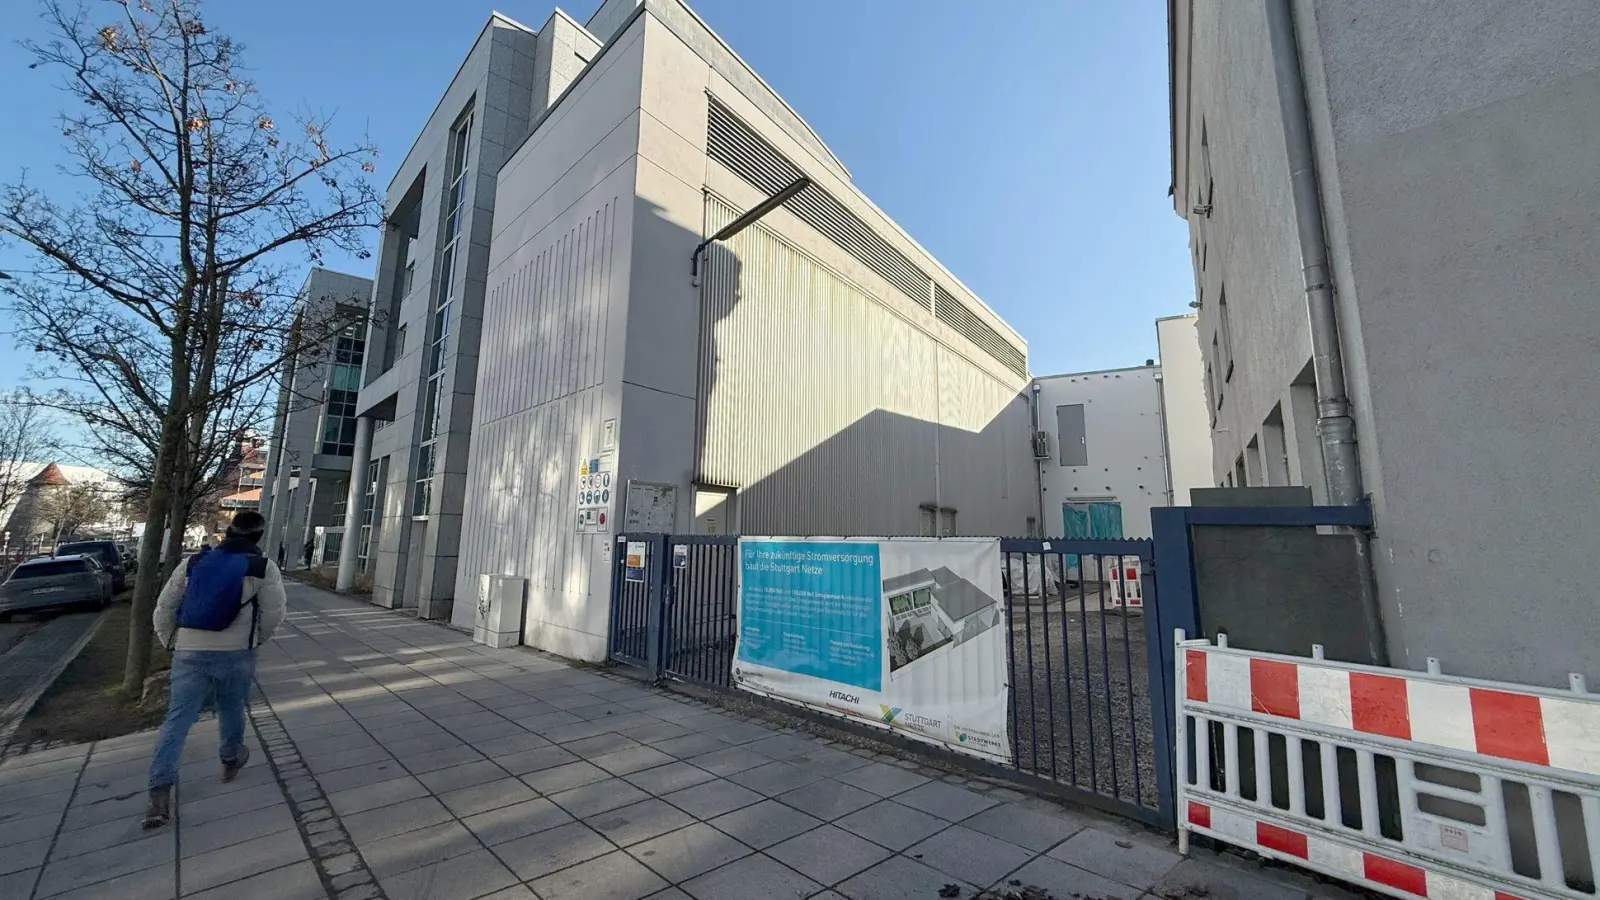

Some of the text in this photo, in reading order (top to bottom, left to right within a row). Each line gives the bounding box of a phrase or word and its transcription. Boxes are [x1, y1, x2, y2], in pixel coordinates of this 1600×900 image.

[744, 549, 874, 566] Für Ihre zukünftige Stromversorgung
[760, 562, 770, 571] die
[770, 562, 801, 575] Stuttgart
[802, 564, 823, 575] Netze
[829, 690, 860, 704] HITACHI
[904, 713, 941, 728] STUTTGART
